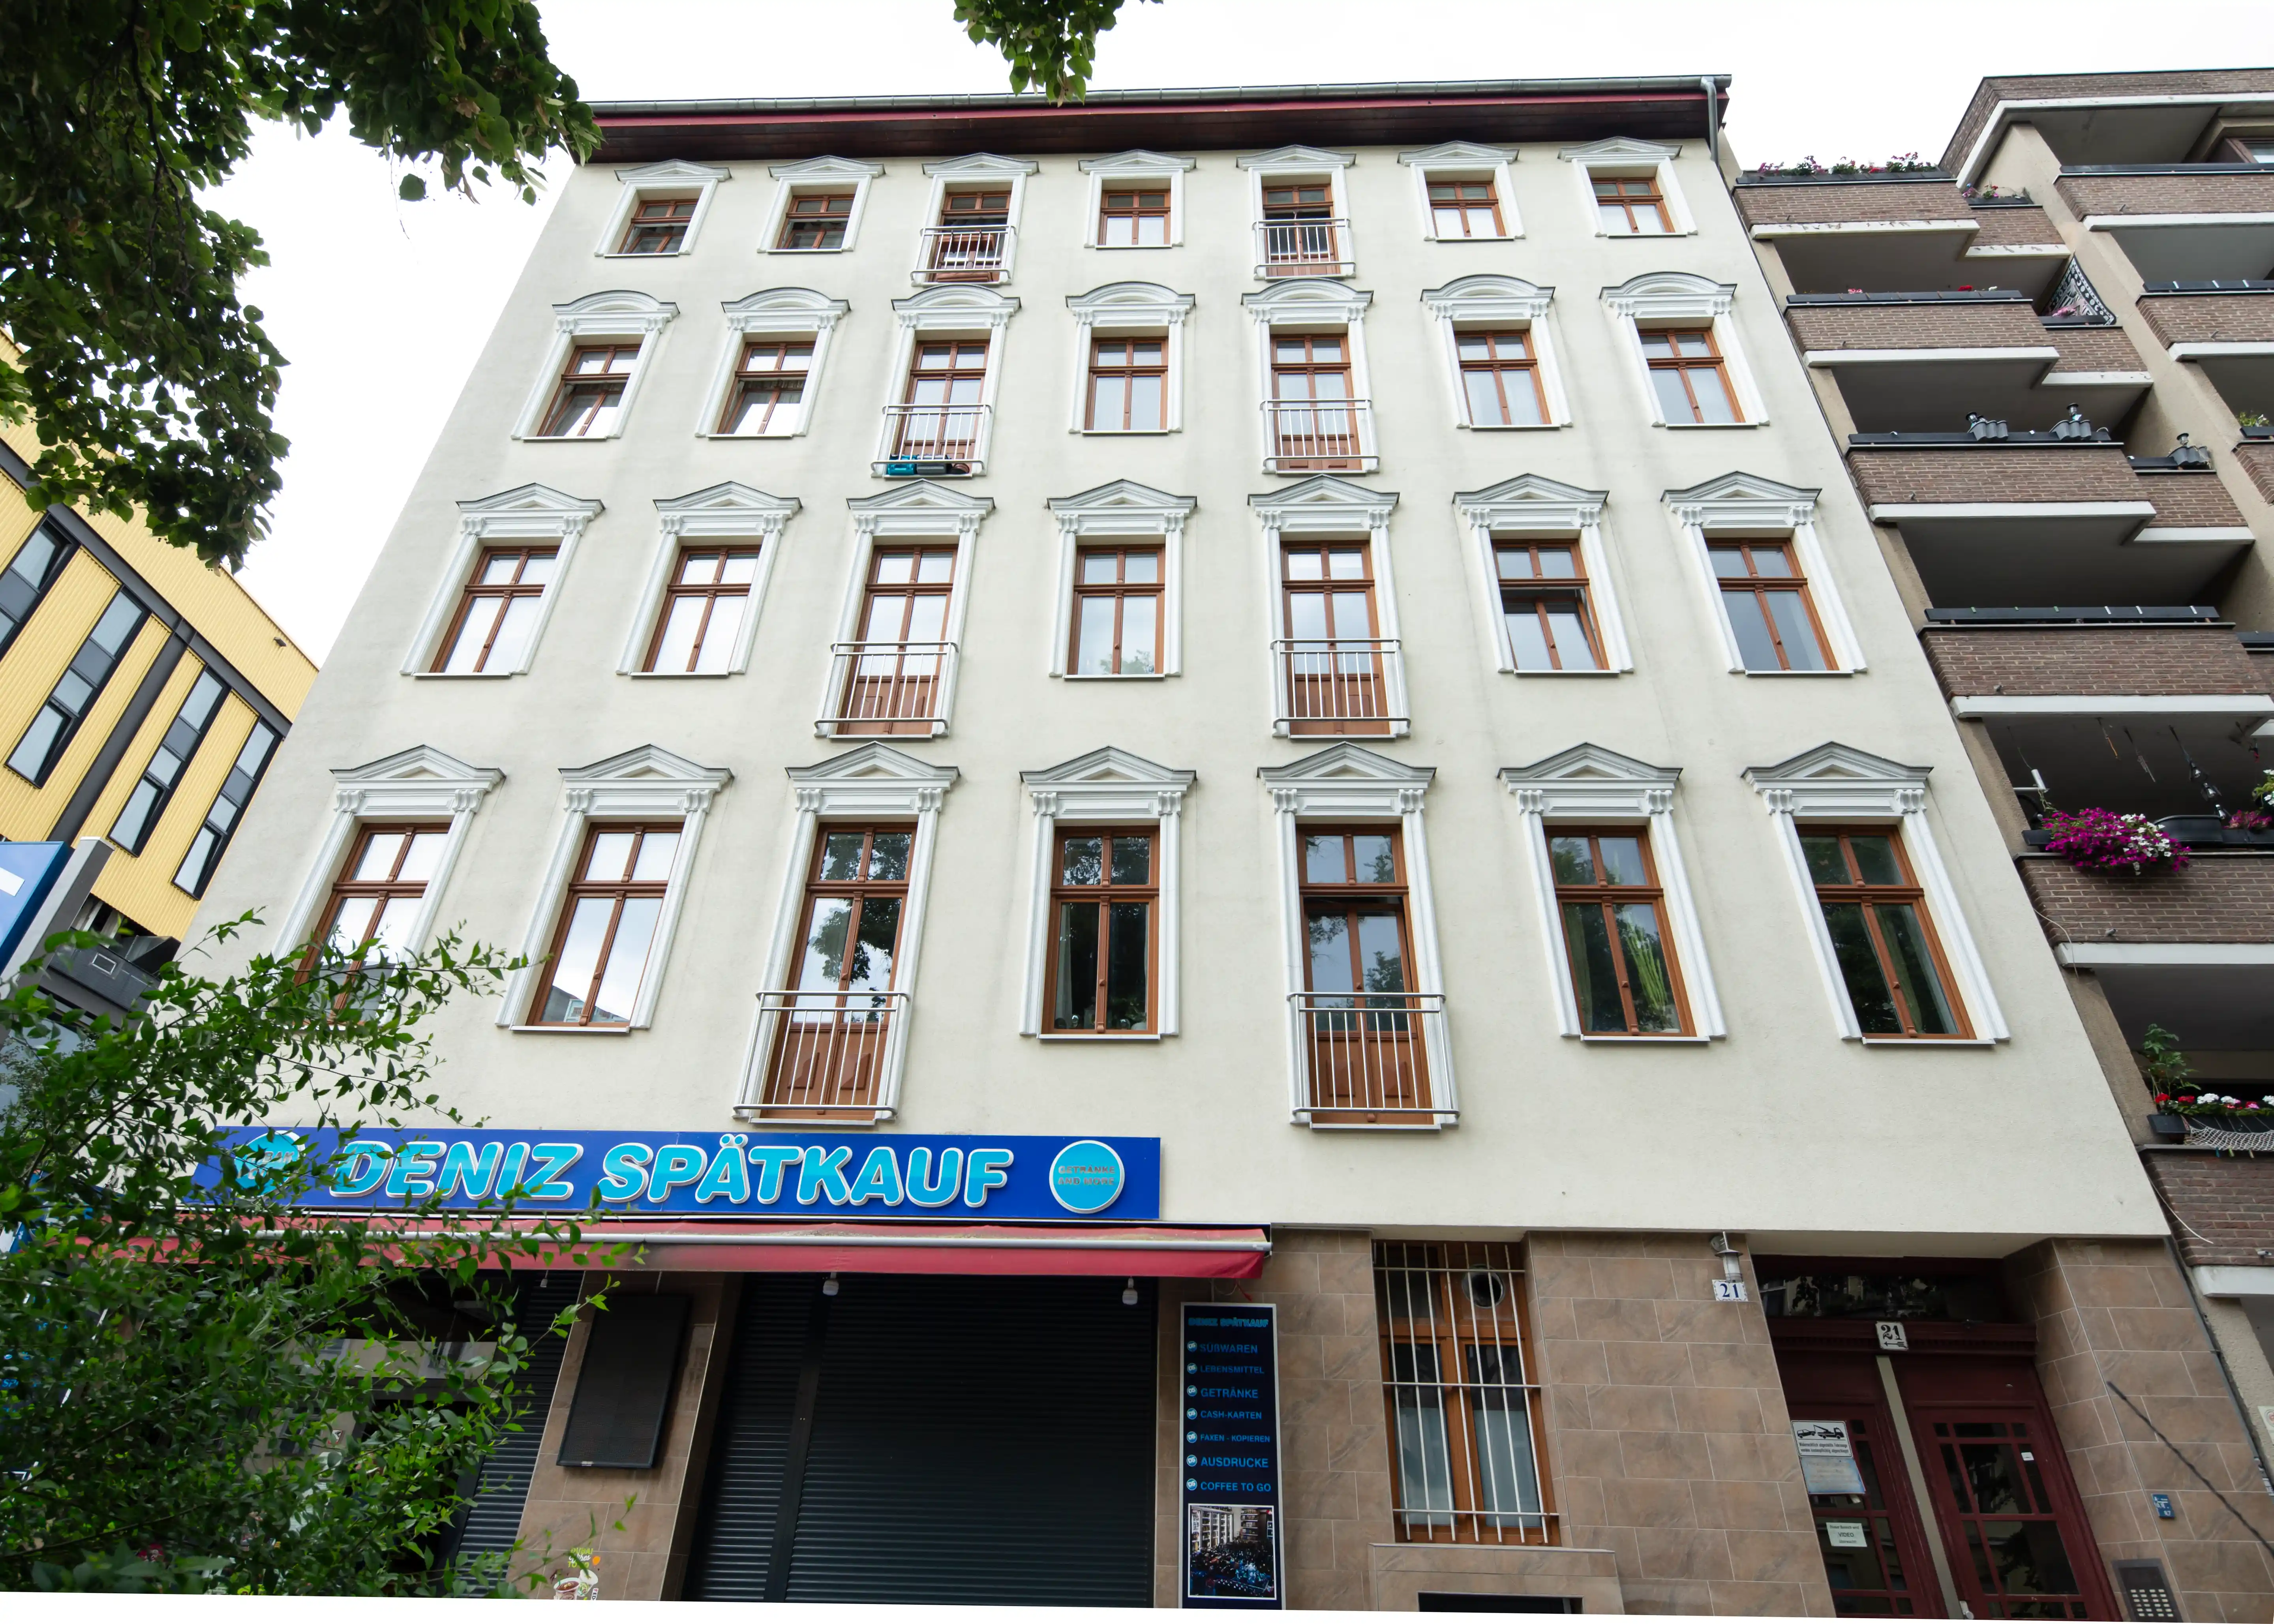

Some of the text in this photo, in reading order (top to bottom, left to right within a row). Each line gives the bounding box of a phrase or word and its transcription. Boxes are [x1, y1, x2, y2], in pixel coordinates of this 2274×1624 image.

[246, 1151, 295, 1167] BAK
[329, 1134, 1014, 1208] DENIZ SPÄTKAUF
[1058, 1165, 1115, 1174] GETRÄNKE
[1720, 1283, 1739, 1298] 21
[1188, 1318, 1218, 1326] DENIZ
[1880, 1324, 1902, 1341] 21
[1201, 1365, 1264, 1374] LEBENSMITTEL
[1201, 1387, 1258, 1397] GETRÄNKE
[1201, 1410, 1262, 1419] CASH-KARTEN
[1201, 1457, 1268, 1468] AUSDRUCKE
[1201, 1482, 1238, 1491] COFFEE
[1241, 1483, 1253, 1491] TO
[1257, 1483, 1271, 1491] GO
